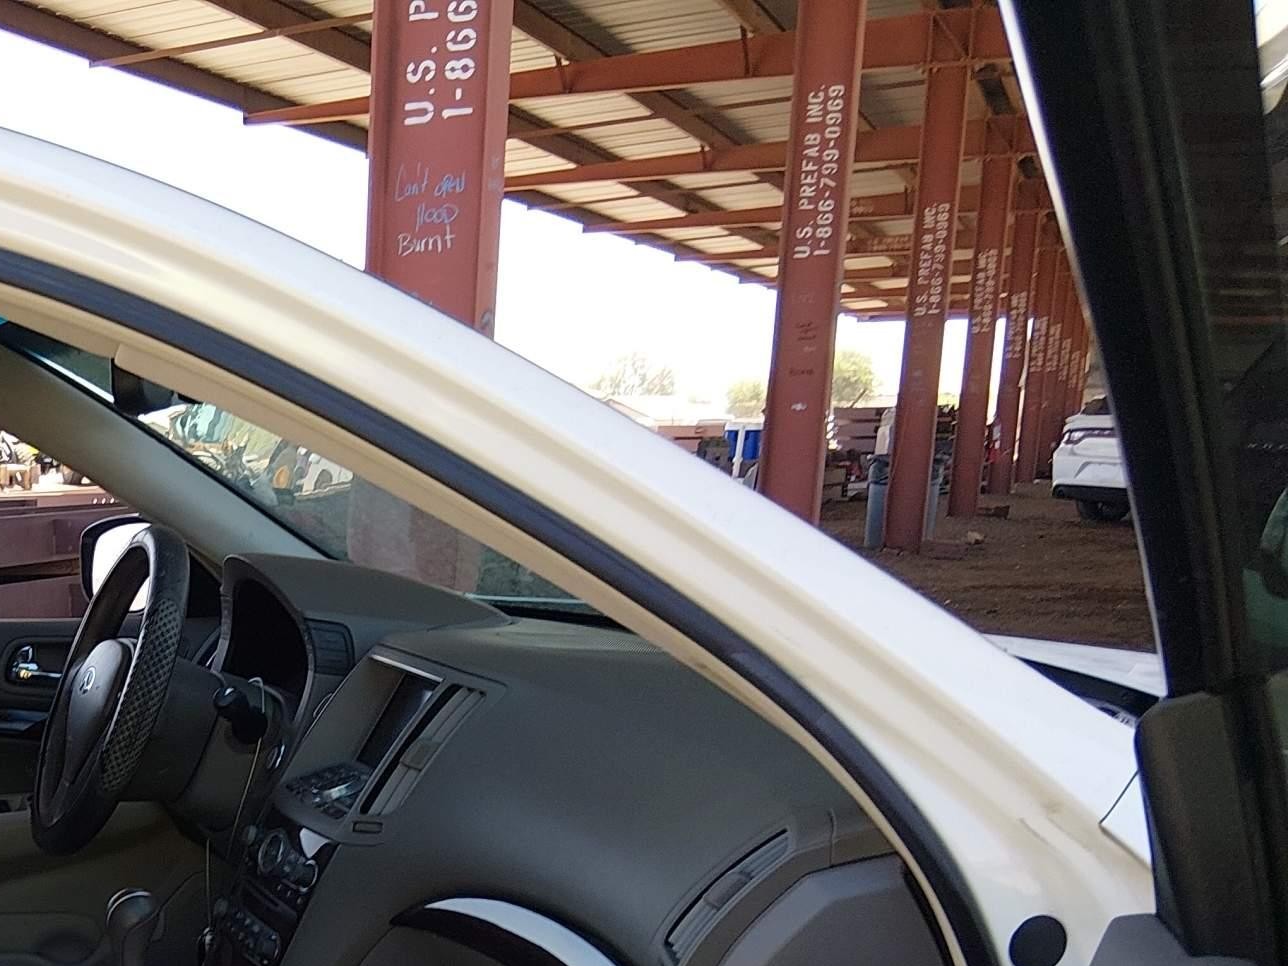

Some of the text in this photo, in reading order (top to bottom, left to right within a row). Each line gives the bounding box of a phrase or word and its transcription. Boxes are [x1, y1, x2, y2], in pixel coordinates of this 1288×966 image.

[404, 0, 439, 125] U.S. P
[442, 0, 478, 119] 1-866
[793, 84, 826, 259] U.S. PREFAB INC.
[813, 84, 845, 256] 1-866-799-0969
[398, 224, 456, 256] Burnt
